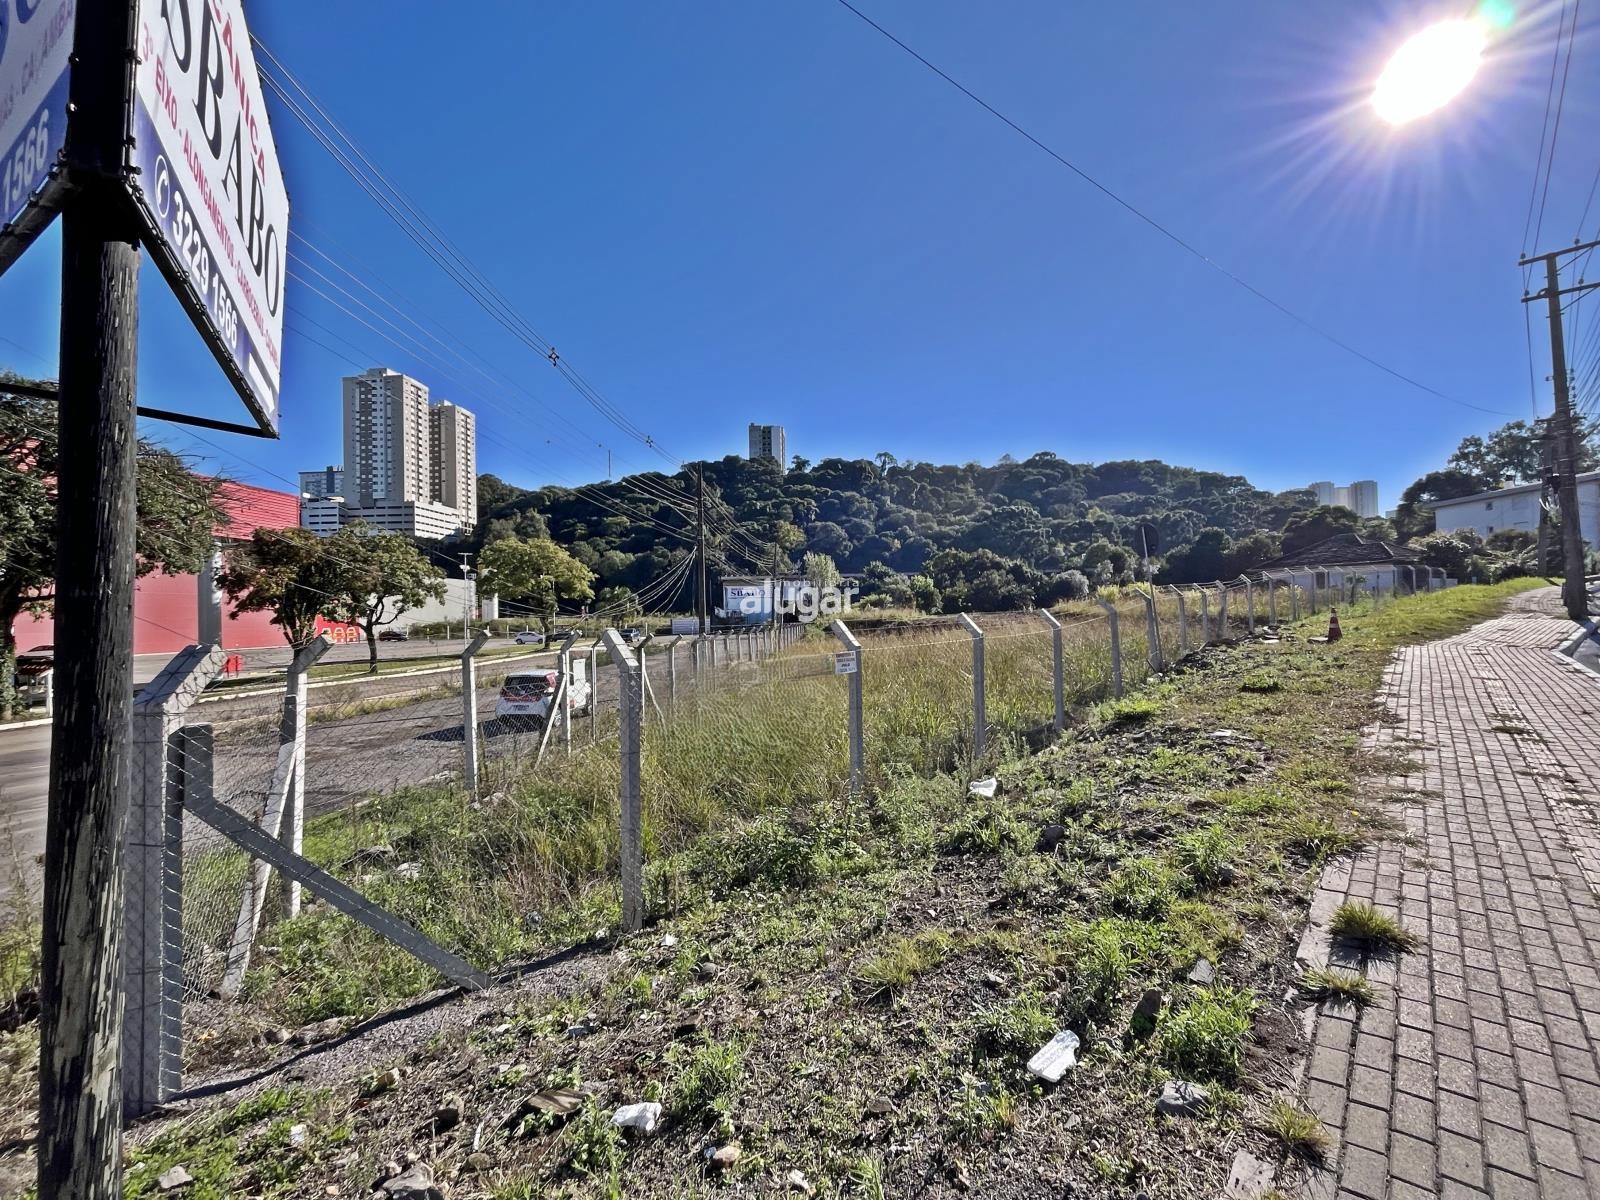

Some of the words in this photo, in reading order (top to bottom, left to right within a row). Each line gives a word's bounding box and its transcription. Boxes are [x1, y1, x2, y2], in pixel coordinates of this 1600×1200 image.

[3, 107, 49, 214] 1566
[155, 54, 178, 130] EIXO
[183, 128, 234, 268] ALONGAMENTOS
[173, 190, 209, 295] 3229
[213, 272, 238, 349] 1566
